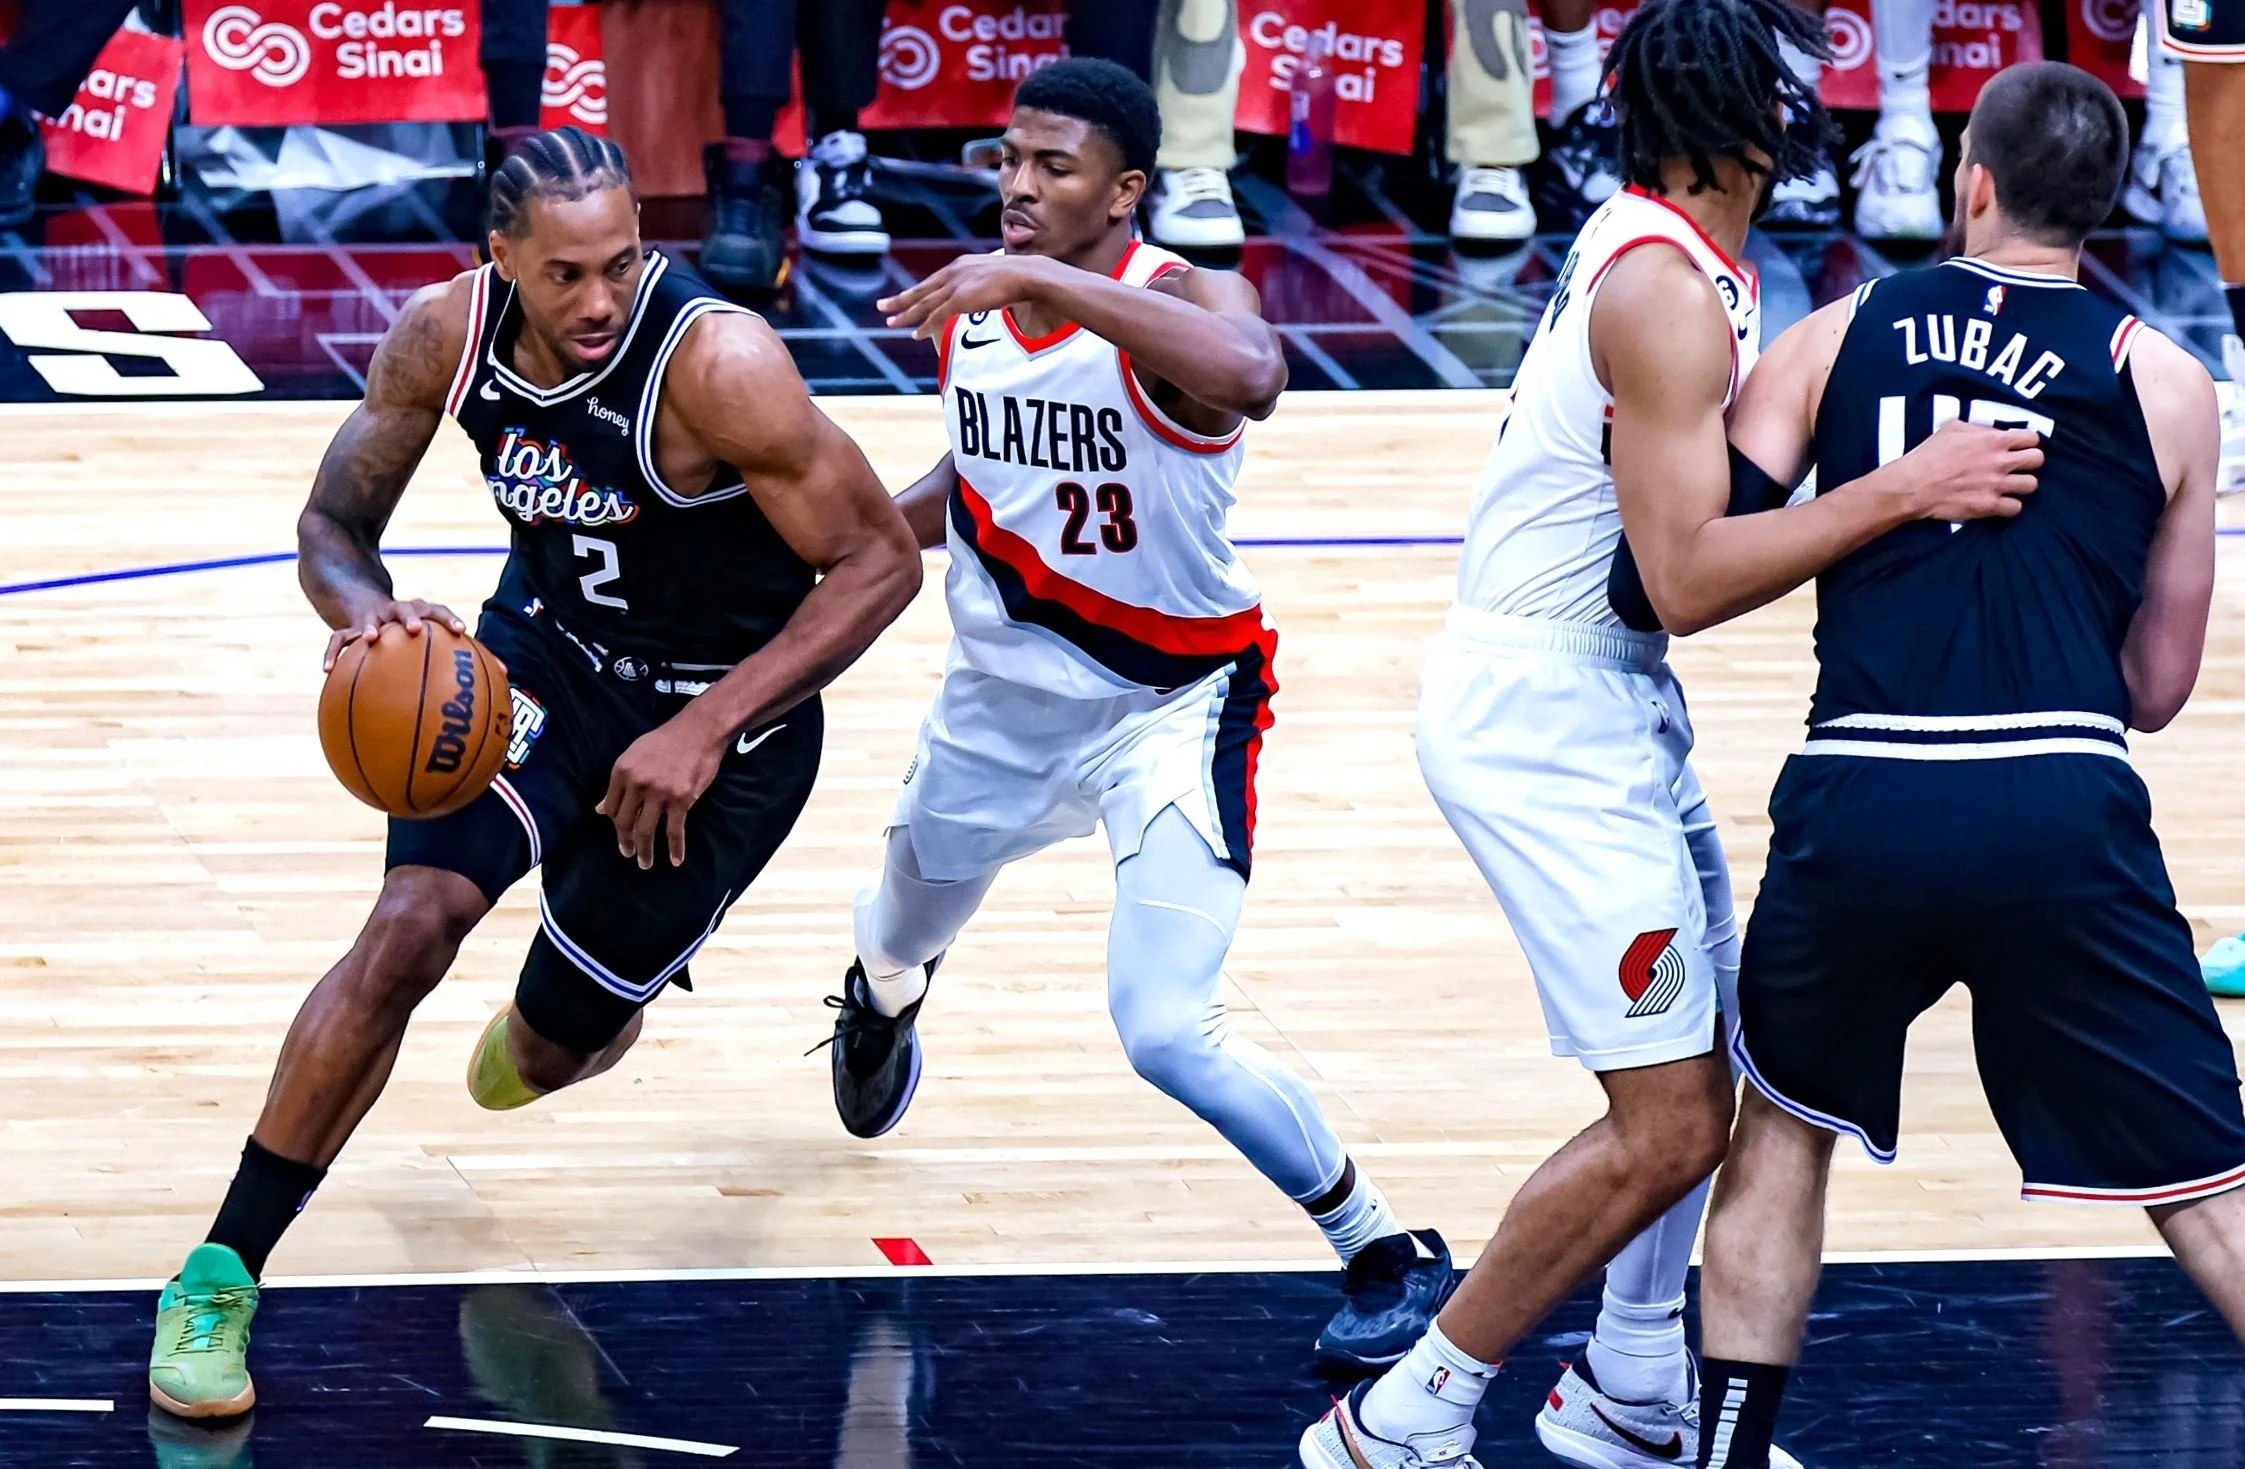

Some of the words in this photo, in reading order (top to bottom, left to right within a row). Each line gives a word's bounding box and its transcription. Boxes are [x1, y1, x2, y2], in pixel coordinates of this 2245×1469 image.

[309, 1, 465, 39] Cedars
[939, 5, 1069, 41] Cedar
[1934, 0, 2022, 31] dars
[336, 39, 443, 79] Sinai
[1250, 11, 1404, 67] Cedars
[966, 44, 1071, 81] Sin
[1268, 54, 1376, 103] Sai
[79, 69, 156, 109] ars
[32, 103, 127, 142] nai
[1893, 314, 2065, 399] ZUBAC
[587, 397, 630, 437] honey
[955, 386, 1127, 472] BLAZERS
[487, 478, 634, 523] ngeles
[1055, 482, 1138, 556] 23
[572, 534, 629, 610] 2
[425, 649, 475, 773] Wilson
